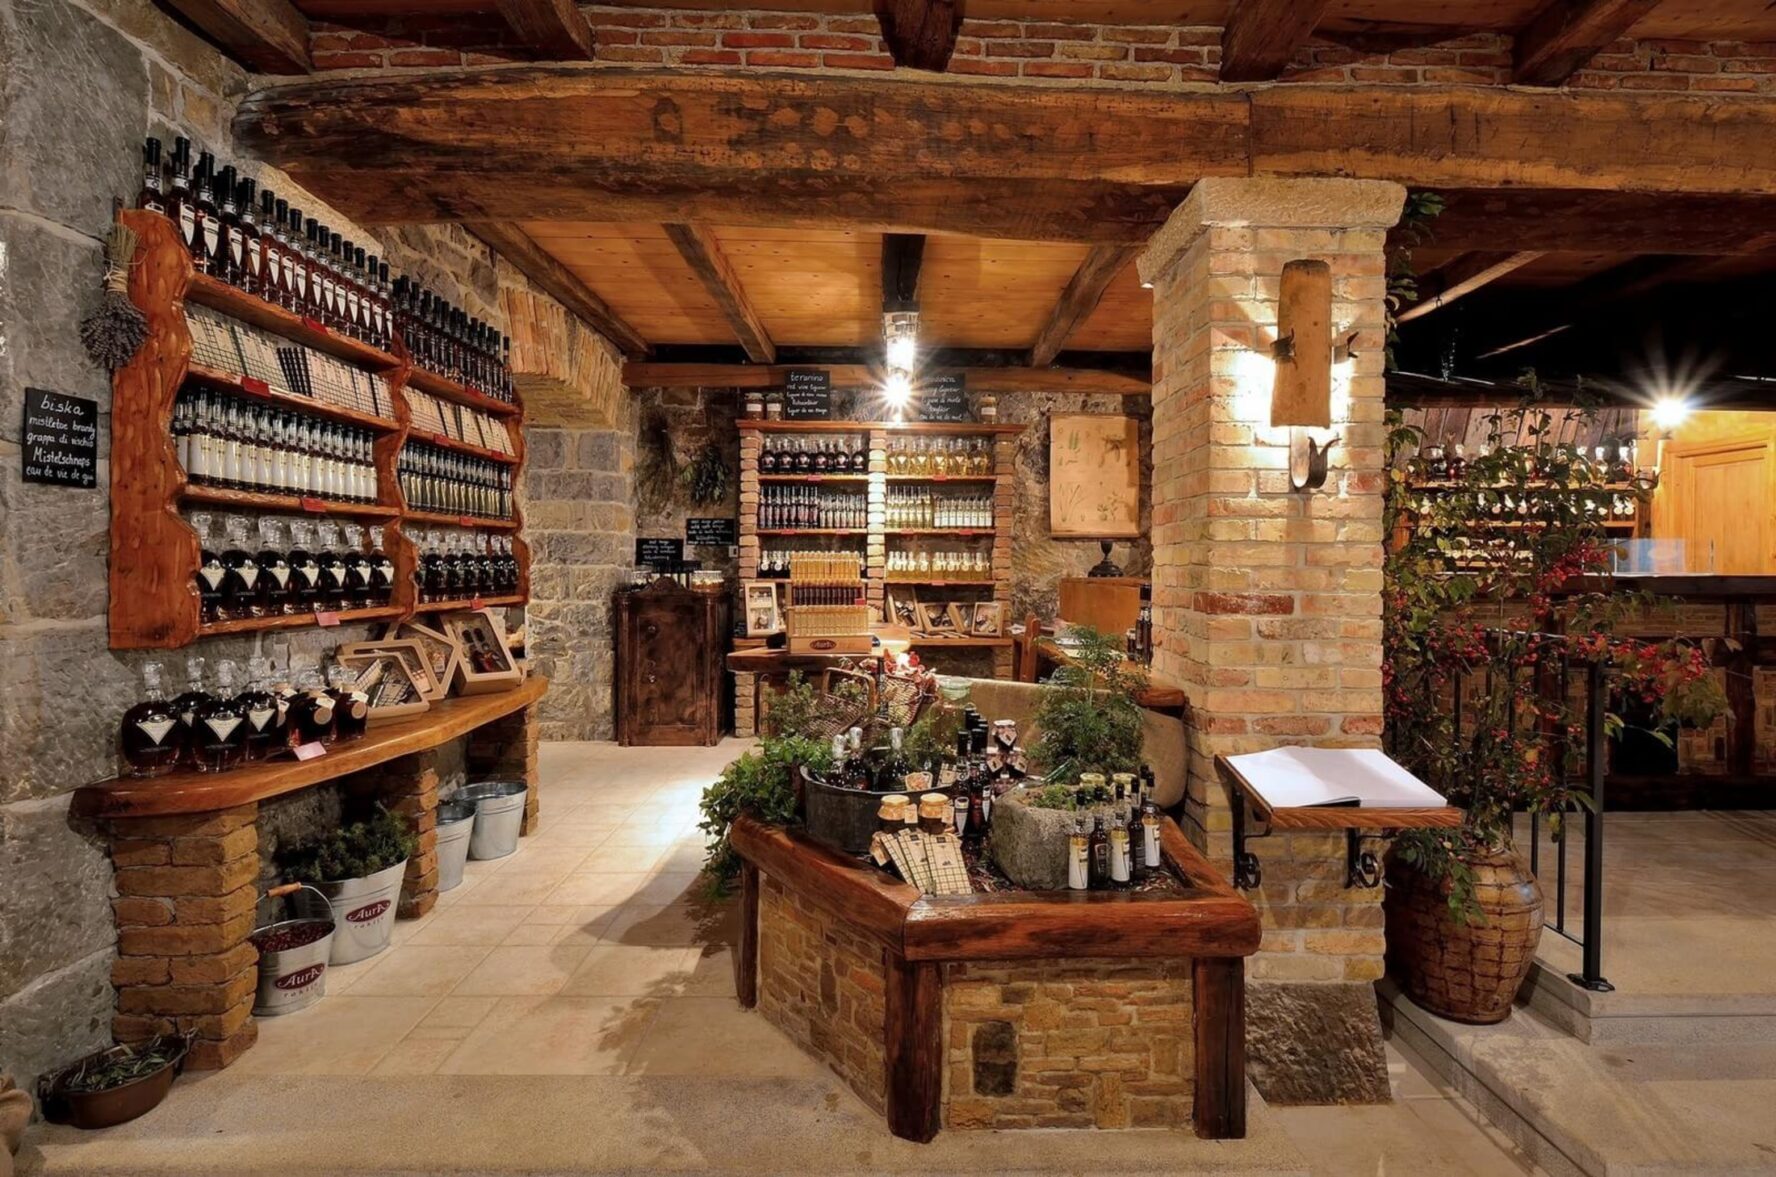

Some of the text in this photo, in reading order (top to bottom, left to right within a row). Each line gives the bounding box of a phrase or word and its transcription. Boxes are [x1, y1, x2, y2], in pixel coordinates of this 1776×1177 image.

[40, 394, 85, 416] biska
[28, 415, 96, 441] mistletoe brandy
[26, 432, 56, 446] grappa
[59, 433, 69, 444] di
[26, 465, 42, 476] eau
[44, 465, 54, 477] de
[57, 468, 69, 479] vie
[71, 468, 80, 480] de
